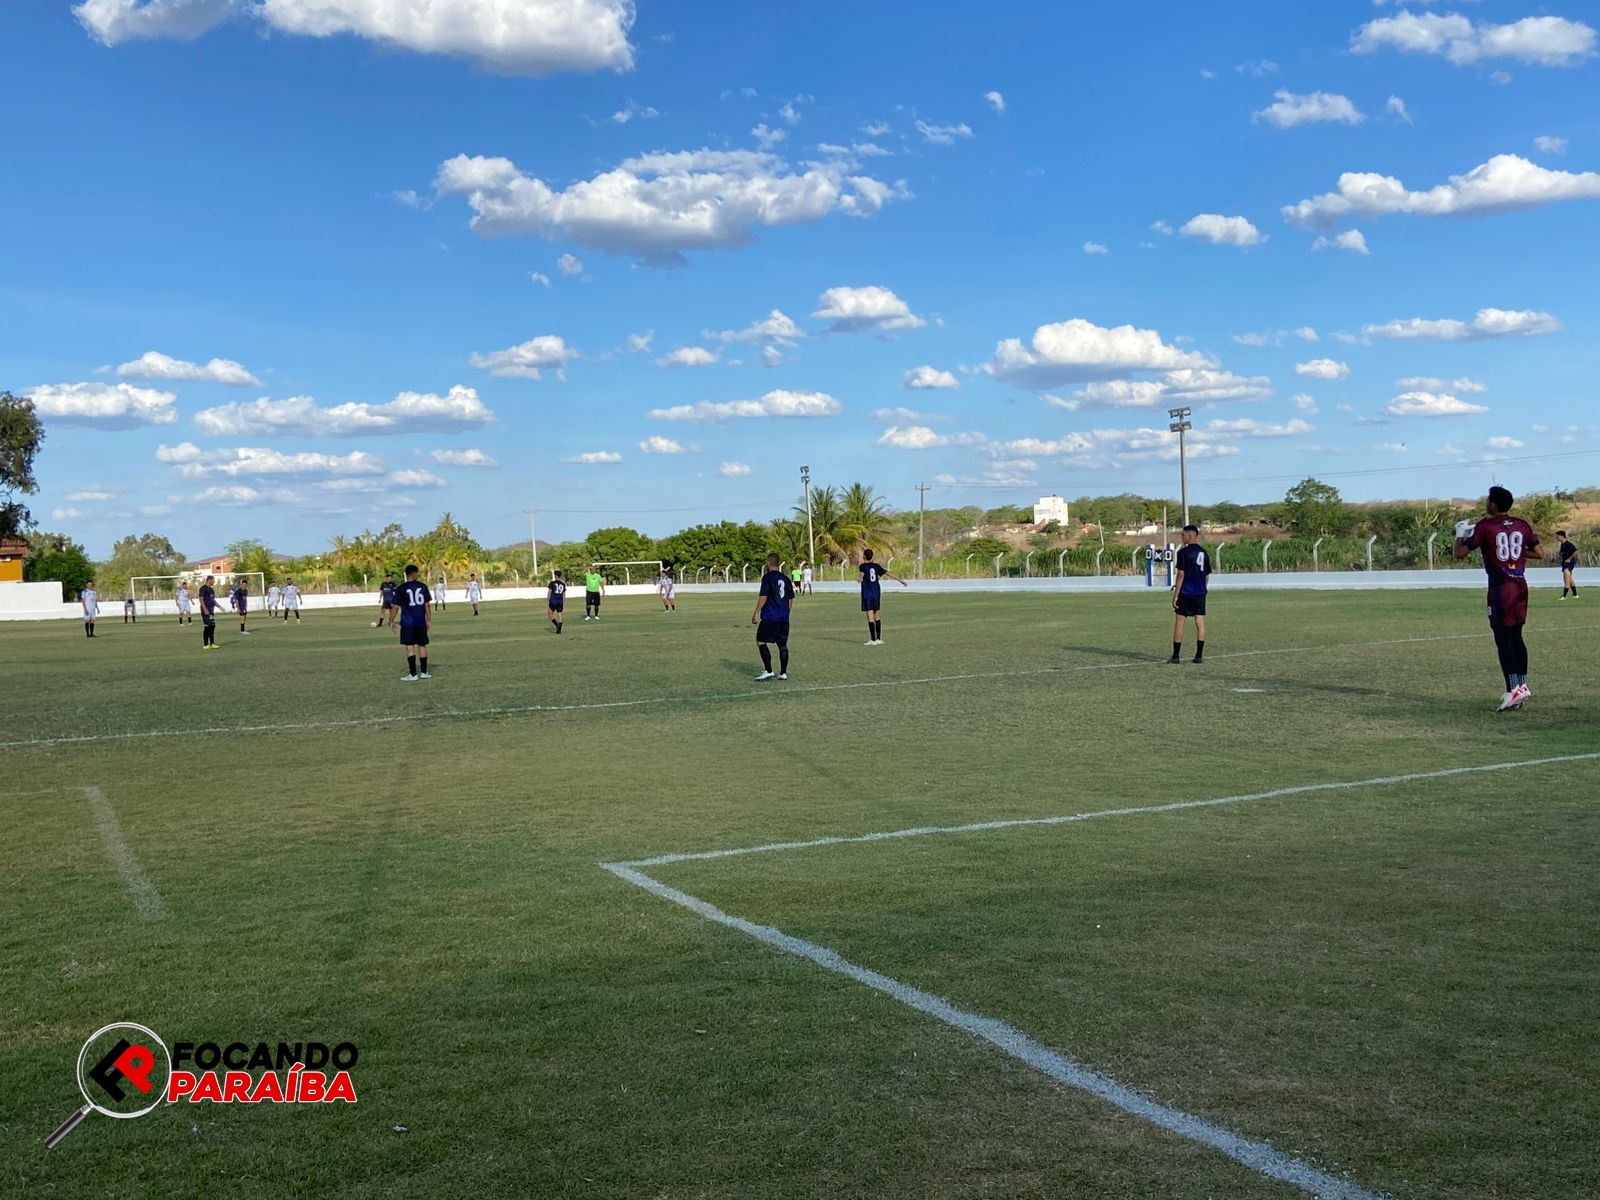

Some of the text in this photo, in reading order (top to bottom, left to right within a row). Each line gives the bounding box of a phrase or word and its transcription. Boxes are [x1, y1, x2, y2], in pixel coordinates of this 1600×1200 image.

[1145, 549, 1151, 559] 0
[1165, 550, 1172, 561] 0
[1495, 531, 1523, 561] 88
[1196, 551, 1205, 571] 4
[869, 568, 876, 582] 8
[406, 587, 425, 606] 16
[554, 583, 564, 594] 19
[777, 579, 785, 598] 3
